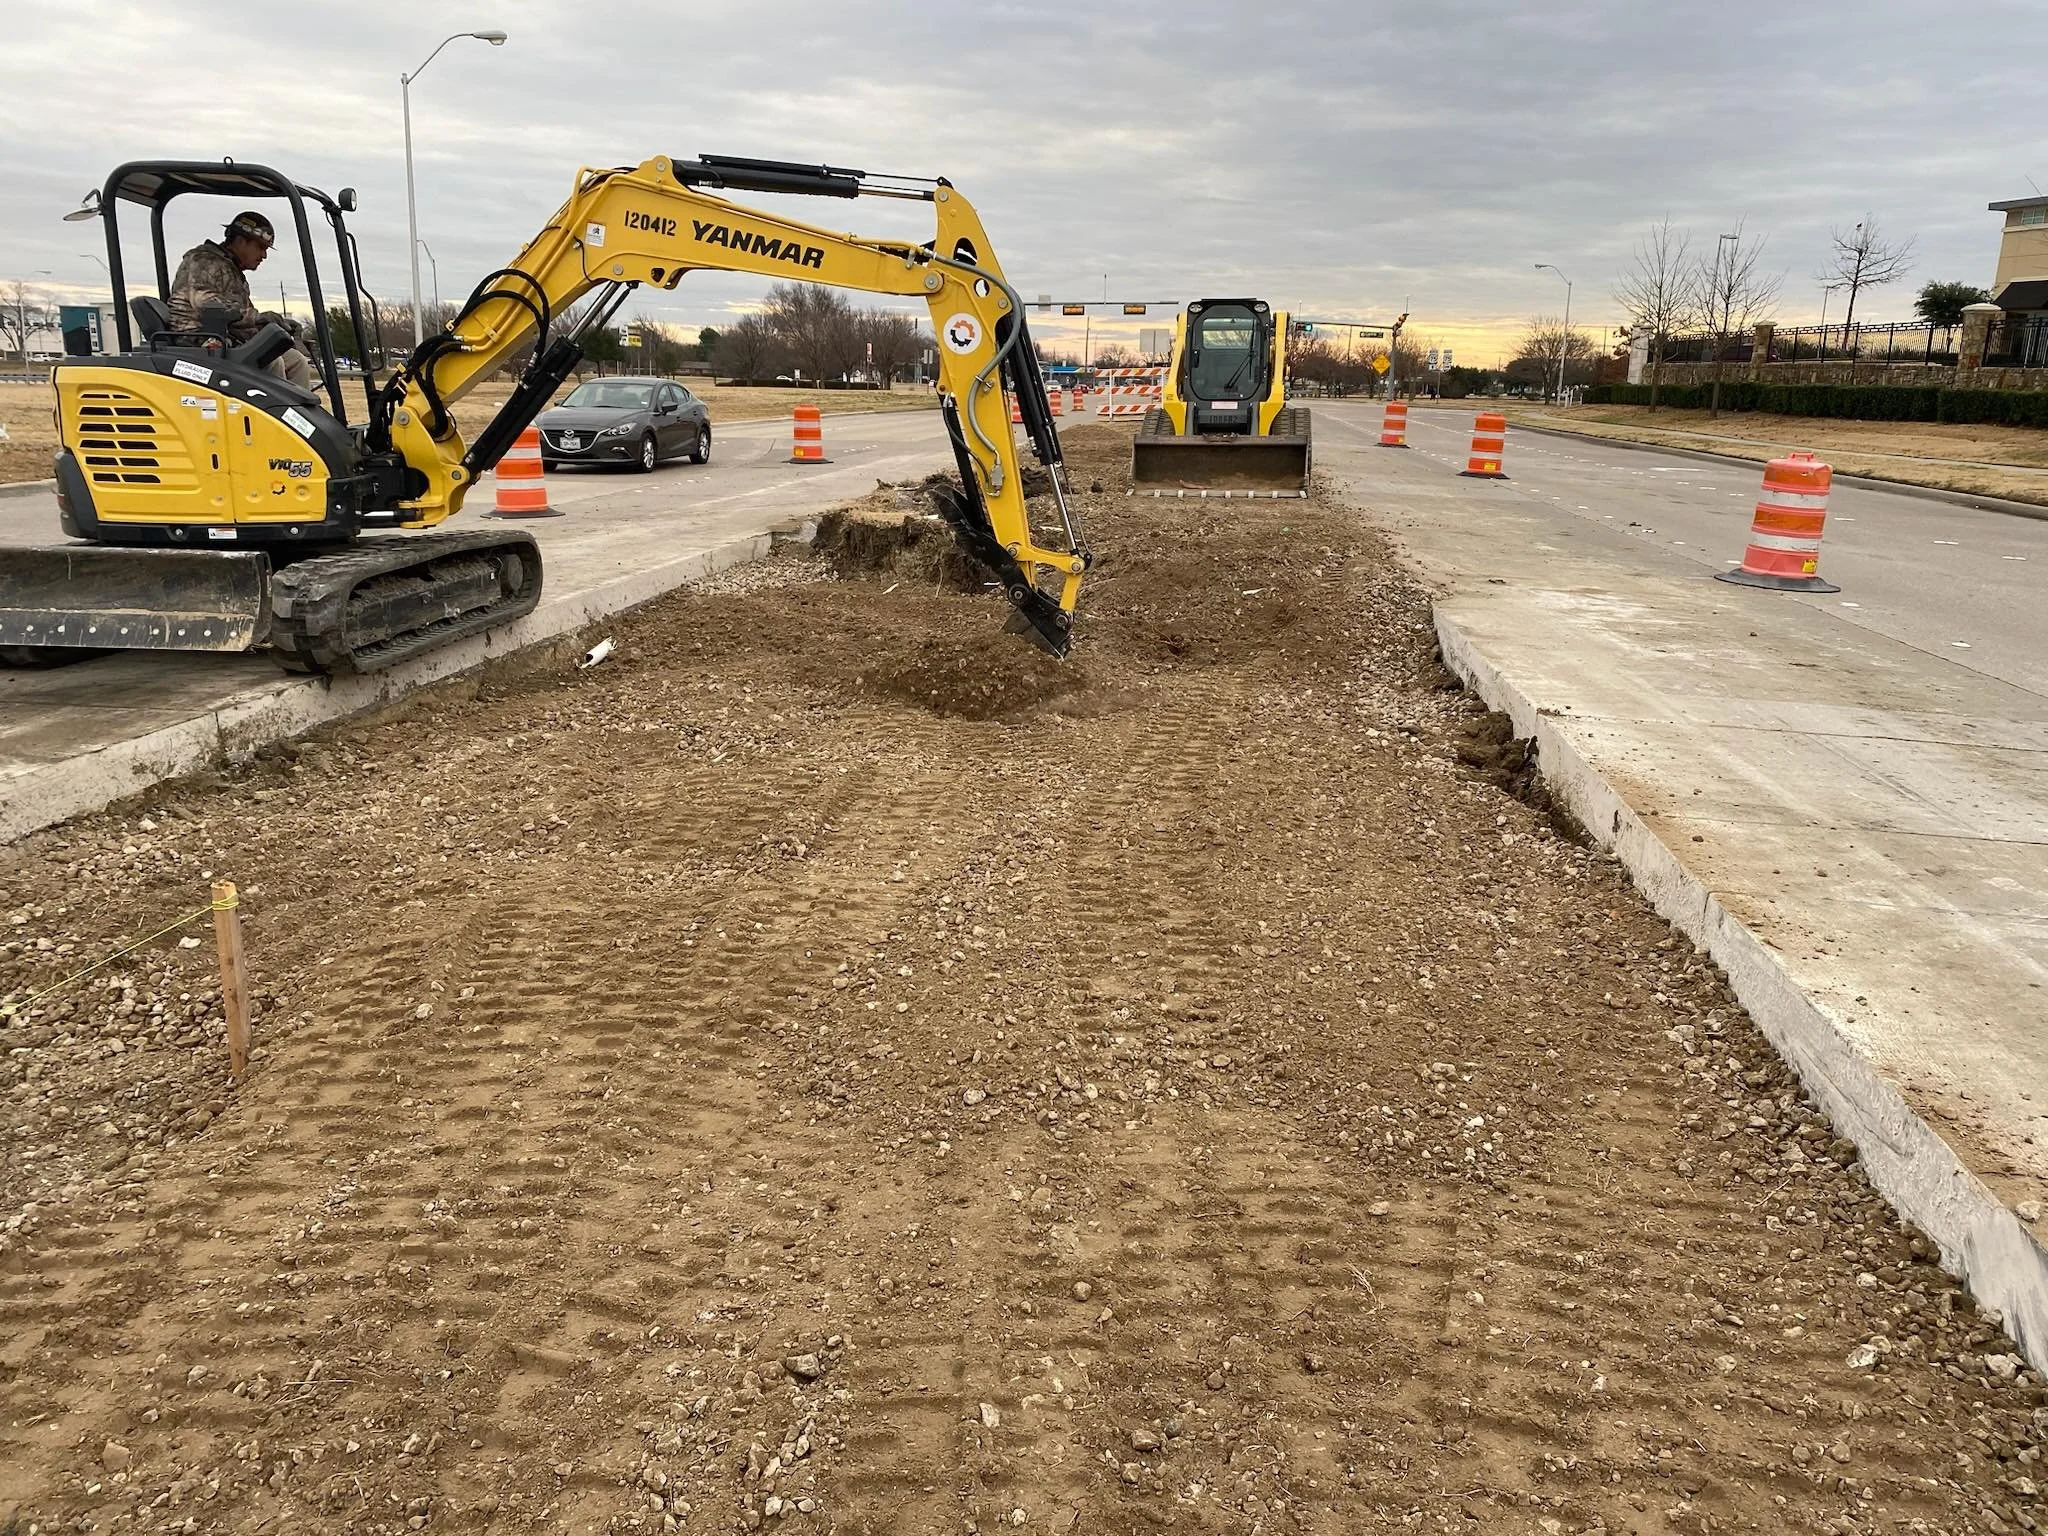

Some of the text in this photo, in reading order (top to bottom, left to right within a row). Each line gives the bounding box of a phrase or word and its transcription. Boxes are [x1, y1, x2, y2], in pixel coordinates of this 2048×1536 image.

[624, 210, 677, 236] 120412
[692, 220, 825, 269] YANMAR
[191, 373, 208, 381] ONLY
